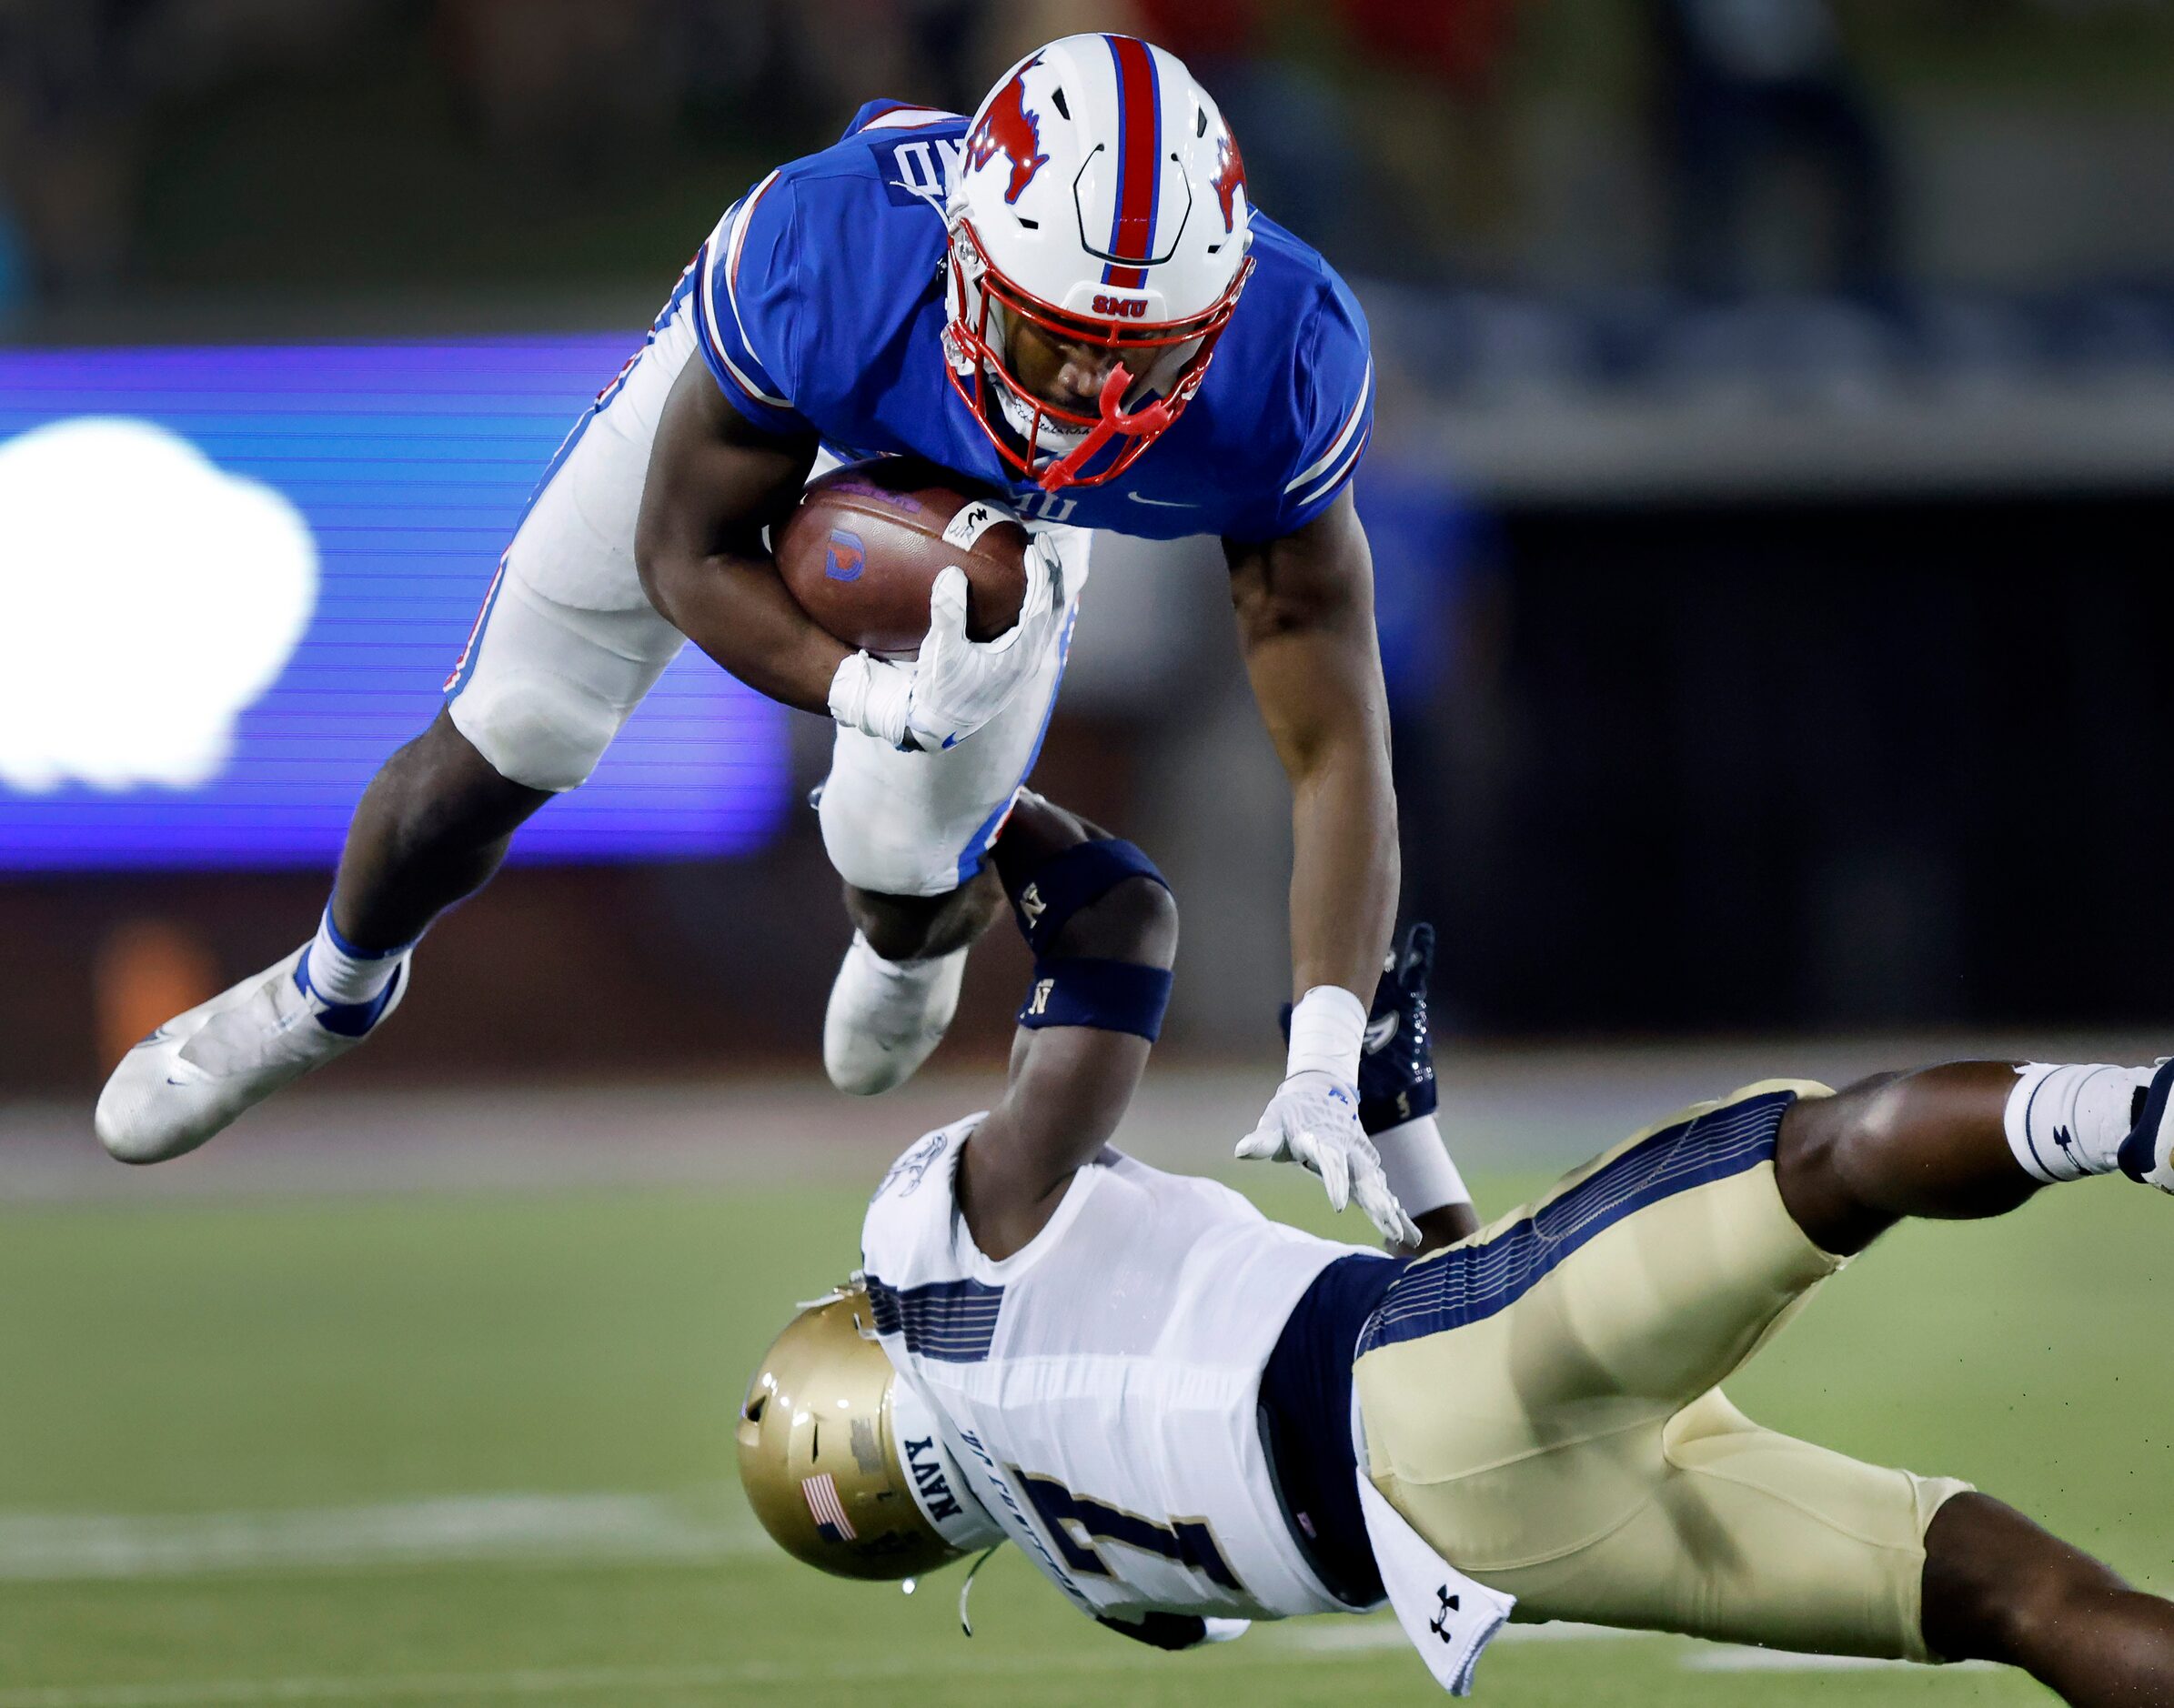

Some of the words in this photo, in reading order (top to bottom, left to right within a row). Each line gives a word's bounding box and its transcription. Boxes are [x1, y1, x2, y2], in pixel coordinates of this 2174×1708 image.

[1092, 295, 1148, 317] SMU
[1028, 980, 1055, 1015] N
[904, 1436, 962, 1522] NAVY
